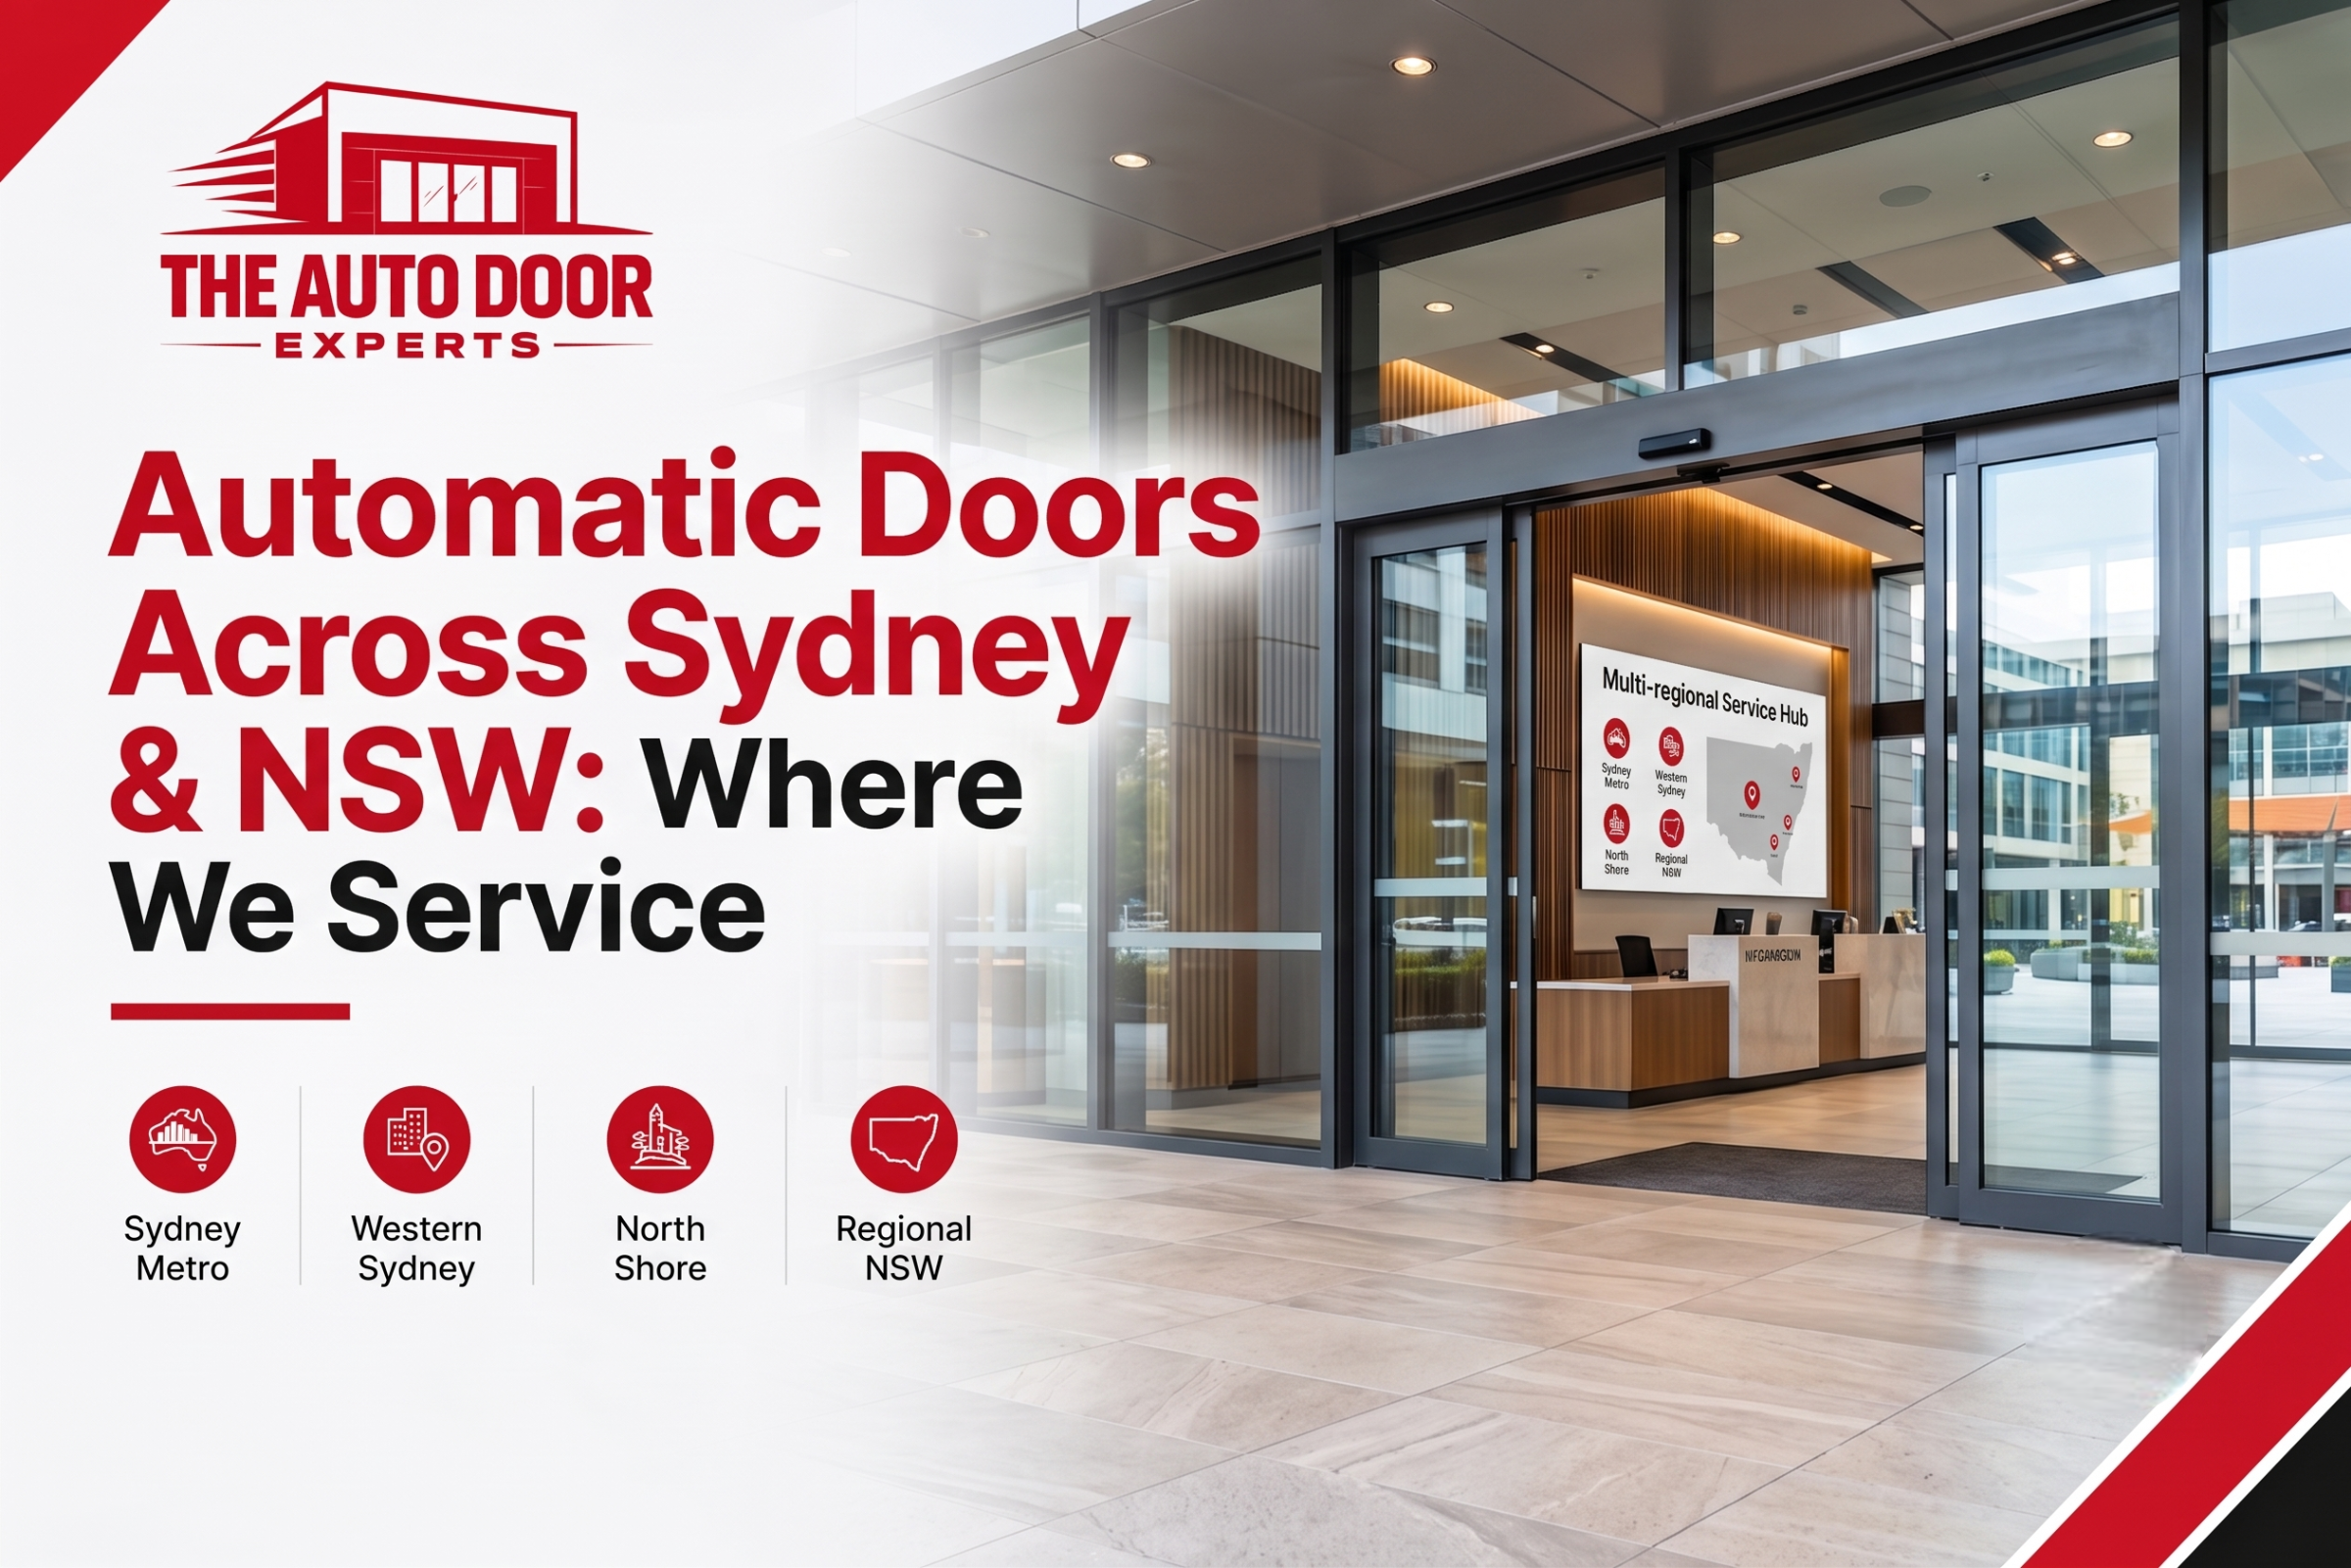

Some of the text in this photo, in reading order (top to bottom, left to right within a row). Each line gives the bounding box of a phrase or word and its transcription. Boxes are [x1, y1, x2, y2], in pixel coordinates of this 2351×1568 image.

[1603, 666, 1809, 728] Multi-regional Service Hub
[1602, 762, 1631, 780] Sydney
[1605, 777, 1629, 789] Metro
[1657, 784, 1686, 799] Sydney
[1605, 849, 1629, 861] North
[1655, 852, 1688, 866] Regional
